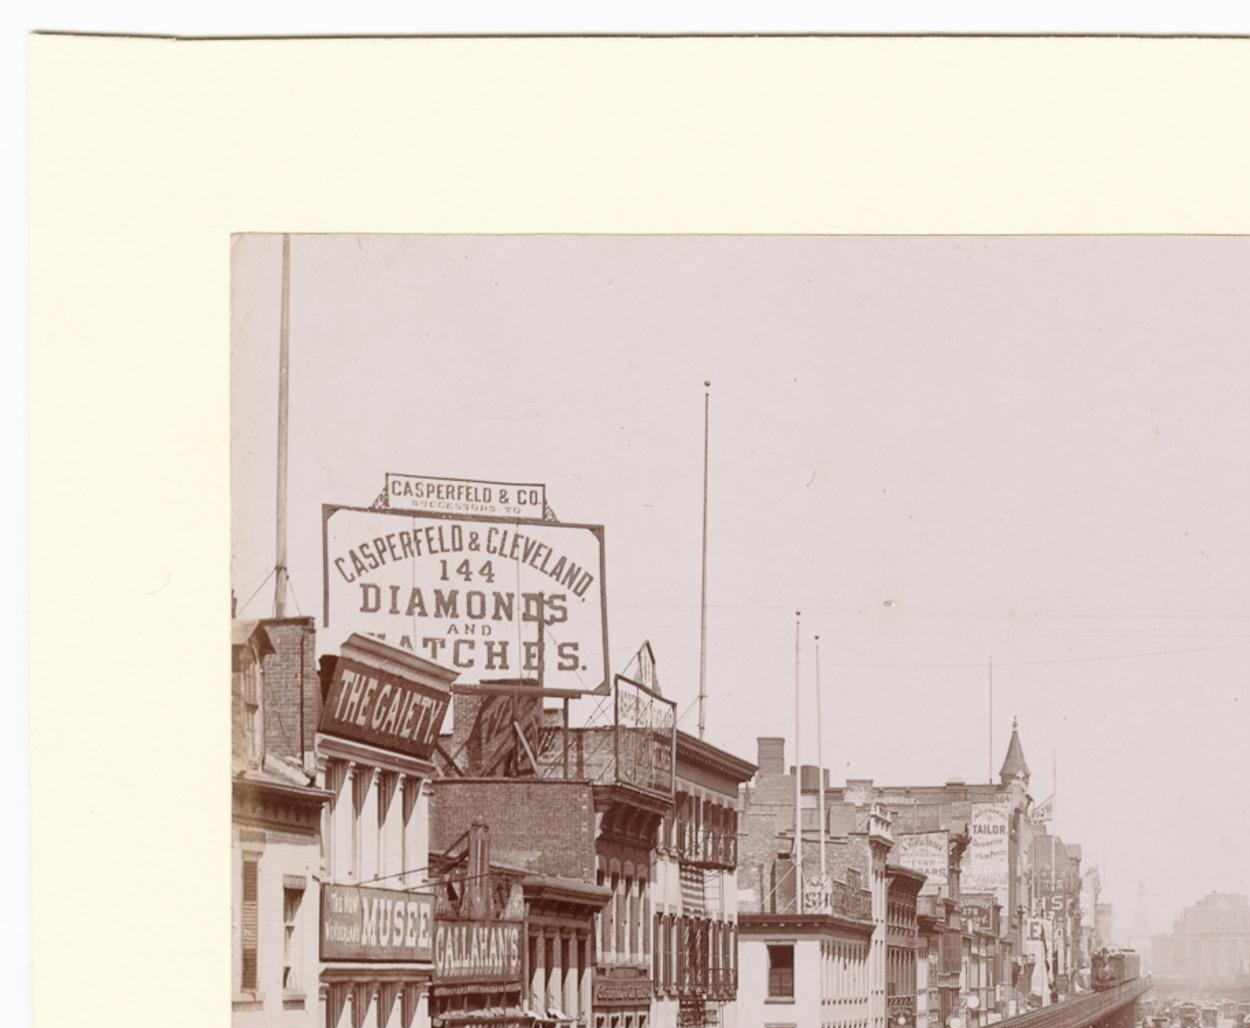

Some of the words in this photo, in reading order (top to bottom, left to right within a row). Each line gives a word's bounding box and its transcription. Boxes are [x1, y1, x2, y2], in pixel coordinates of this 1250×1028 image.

[391, 480, 492, 503] CASPERFELD
[498, 489, 510, 505] &
[334, 524, 463, 583] CASPERFELD
[469, 531, 481, 552] &
[440, 558, 496, 583] 144
[359, 583, 568, 623] DIAMONDS
[447, 623, 492, 636] AND
[366, 632, 588, 671] TCHES.
[334, 669, 379, 727] THE
